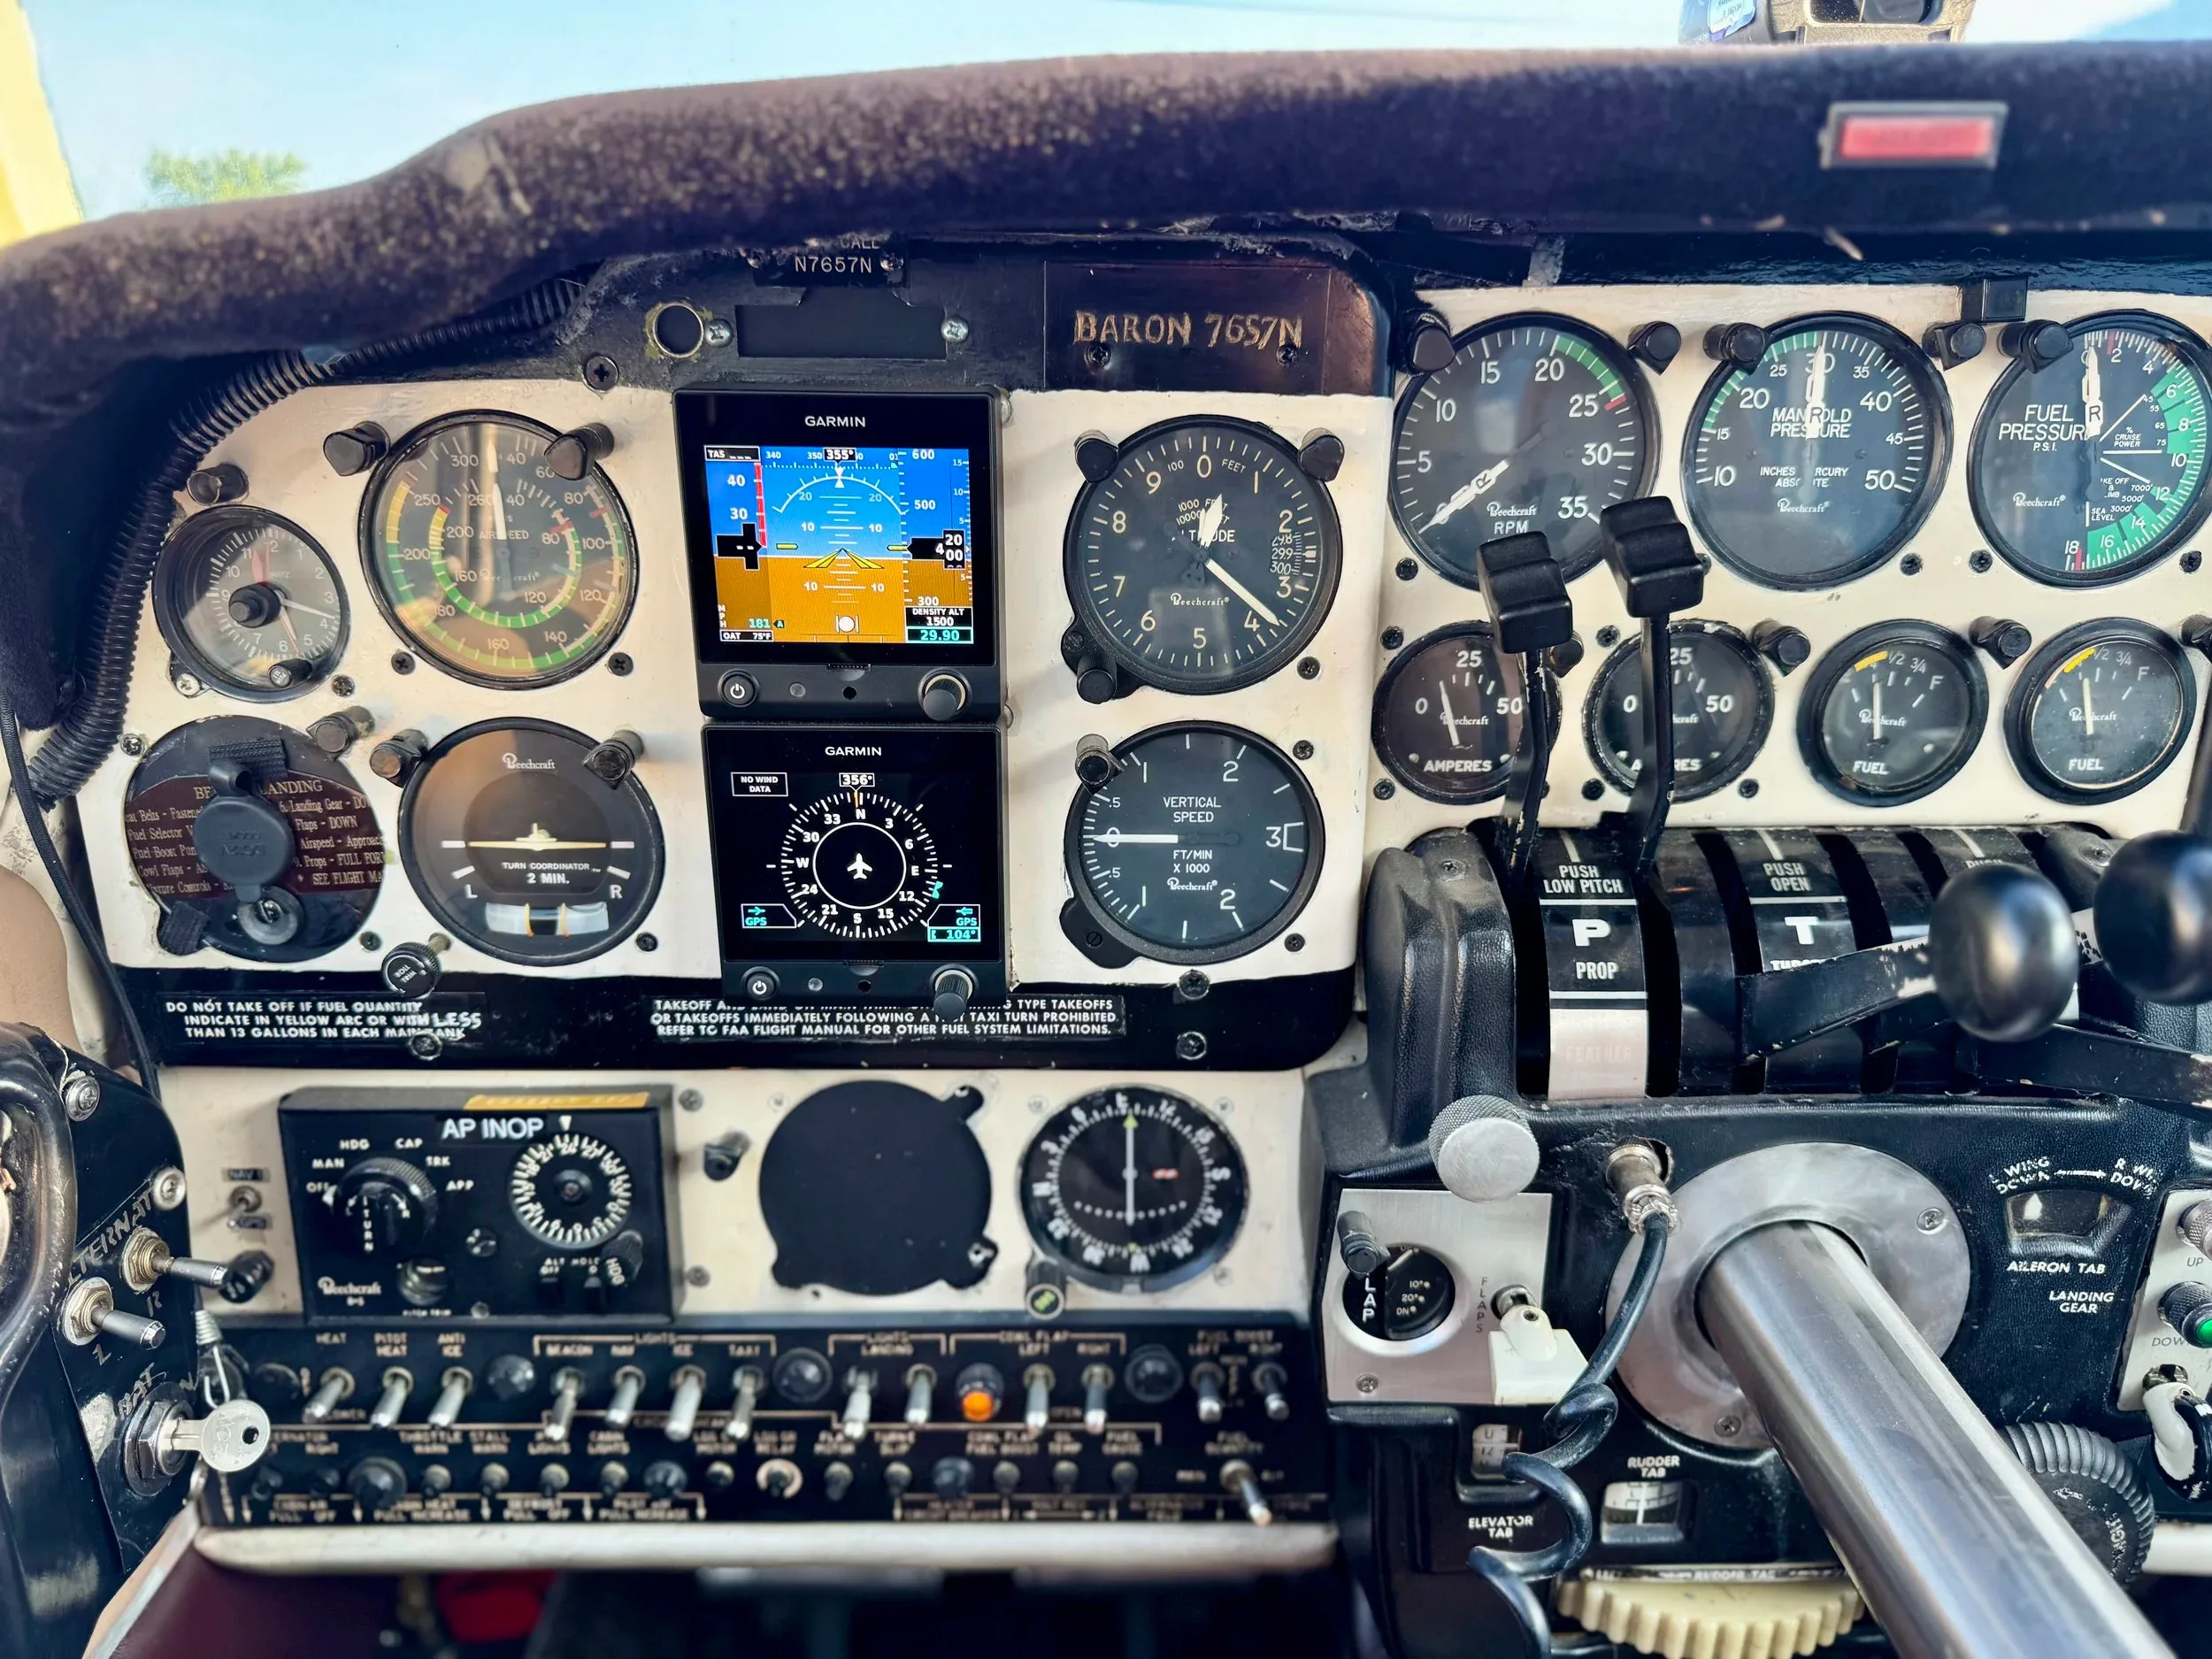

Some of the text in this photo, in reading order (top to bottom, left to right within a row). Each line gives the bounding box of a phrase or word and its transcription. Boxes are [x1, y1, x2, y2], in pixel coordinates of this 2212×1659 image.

[795, 257, 872, 273] N7657N
[1073, 311, 1302, 349] BARON 7657N
[2111, 349, 2122, 363] 2
[1534, 357, 1564, 381] 20
[1860, 391, 1892, 411] 40
[2024, 404, 2074, 422] FUEL
[804, 416, 866, 427] GARMIN
[451, 455, 479, 466] 300
[912, 449, 935, 460] 600
[1581, 442, 1613, 466] 30
[2170, 453, 2187, 468] 10
[1221, 458, 1247, 474] FEET
[1760, 466, 1795, 476] INCHES
[1146, 472, 1162, 495] 9
[1864, 470, 1895, 490] 50
[1178, 499, 1200, 511] 1000
[1486, 502, 1537, 518] Beechcraft
[446, 527, 473, 538] 200
[1494, 520, 1529, 534] RPM
[1141, 610, 1156, 632] 6
[920, 630, 960, 641] 29.90
[2138, 666, 2150, 680] F
[825, 746, 882, 757] GARMIN
[503, 752, 556, 770] Beechcraft
[1424, 759, 1493, 772] AMPERES
[1853, 761, 1889, 775] FUEL
[2069, 758, 2104, 772] FUEL
[291, 798, 345, 813] Landing Gear
[1163, 796, 1222, 808] VERTICAL
[139, 809, 160, 822] Belts
[1173, 811, 1215, 823] SPEED
[294, 816, 358, 832] Flaps DOWN
[149, 826, 184, 840] Selector
[1265, 826, 1282, 848] 3
[155, 846, 178, 858] Boost
[1173, 849, 1213, 860] FT/MIN
[304, 853, 363, 869] Props FULL
[530, 862, 590, 871] COORDINATOR
[161, 864, 184, 878] Flaps
[1173, 864, 1210, 873] X 1000
[1558, 864, 1600, 879] PUSH
[1763, 863, 1805, 877] PUSH
[312, 871, 365, 885] SEE FLIGHT
[526, 872, 570, 884] 2 MIN.
[1770, 877, 1810, 892] OPEN
[177, 881, 212, 895] Controls
[610, 885, 623, 899] R
[1543, 879, 1624, 894] LOW PITCH
[1219, 888, 1236, 910] 2
[878, 908, 895, 919] 15
[745, 918, 767, 926] GPS
[956, 917, 978, 926] GPS
[1571, 918, 1611, 947] P
[1784, 917, 1819, 945] T
[1575, 961, 1618, 980] PROP
[166, 1002, 423, 1012] DO NOT TAKE OFF IF FUEL QUANTITY
[655, 1000, 712, 1010] TAKEOFF
[1018, 999, 1047, 1010] TYPE
[1051, 999, 1113, 1010] TAKEOFFS
[184, 1015, 250, 1026] INDICATE
[255, 1015, 270, 1026] IN
[275, 1015, 330, 1026] YELLOW
[335, 1015, 363, 1026] ARC
[367, 1015, 388, 1026] OR
[433, 1012, 481, 1030] LESS
[650, 1013, 671, 1025] OR
[674, 1013, 740, 1024] TAKEOFFS
[744, 1013, 831, 1024] IMMEDIATELY
[836, 1013, 915, 1024] FOLLOWING
[919, 1013, 930, 1024] A
[970, 1011, 1000, 1022] TAXI
[1004, 1011, 1038, 1022] TURN
[185, 1027, 226, 1039] THAN
[230, 1027, 246, 1039] 13
[251, 1027, 318, 1039] GALLONS
[322, 1027, 339, 1039] IN
[342, 1027, 380, 1039] EACH
[657, 1025, 695, 1035] REFER
[722, 1025, 749, 1035] FAA
[753, 1025, 796, 1035] FLIGHT
[802, 1025, 860, 1035] MANUAL
[864, 1025, 891, 1035] FOR
[896, 1025, 937, 1035] OTHER
[941, 1025, 970, 1035] FUEL
[974, 1025, 1022, 1035] SYSTEM
[1026, 1024, 1112, 1034] LIMITATIONS.
[442, 1116, 544, 1139] AP INOP
[340, 1139, 369, 1150] HDG
[395, 1137, 423, 1149] CAP
[312, 1158, 345, 1169] MAN
[2003, 1156, 2051, 1177] WING
[446, 1180, 474, 1192] APP
[2007, 1261, 2106, 1274] AILERON TAB
[2186, 1257, 2204, 1267] UP
[318, 1276, 381, 1296] Beechcraft
[2049, 1291, 2115, 1302] LANDING
[2059, 1302, 2098, 1314] GEAR
[437, 1333, 465, 1345] ANTI
[376, 1346, 408, 1356] HEAT
[728, 1345, 760, 1356] TAXI
[1627, 1455, 1680, 1469] RUDDER
[1640, 1466, 1666, 1479] TAB
[1469, 1516, 1533, 1530] ELEVATOR
[1488, 1526, 1513, 1539] TAB
